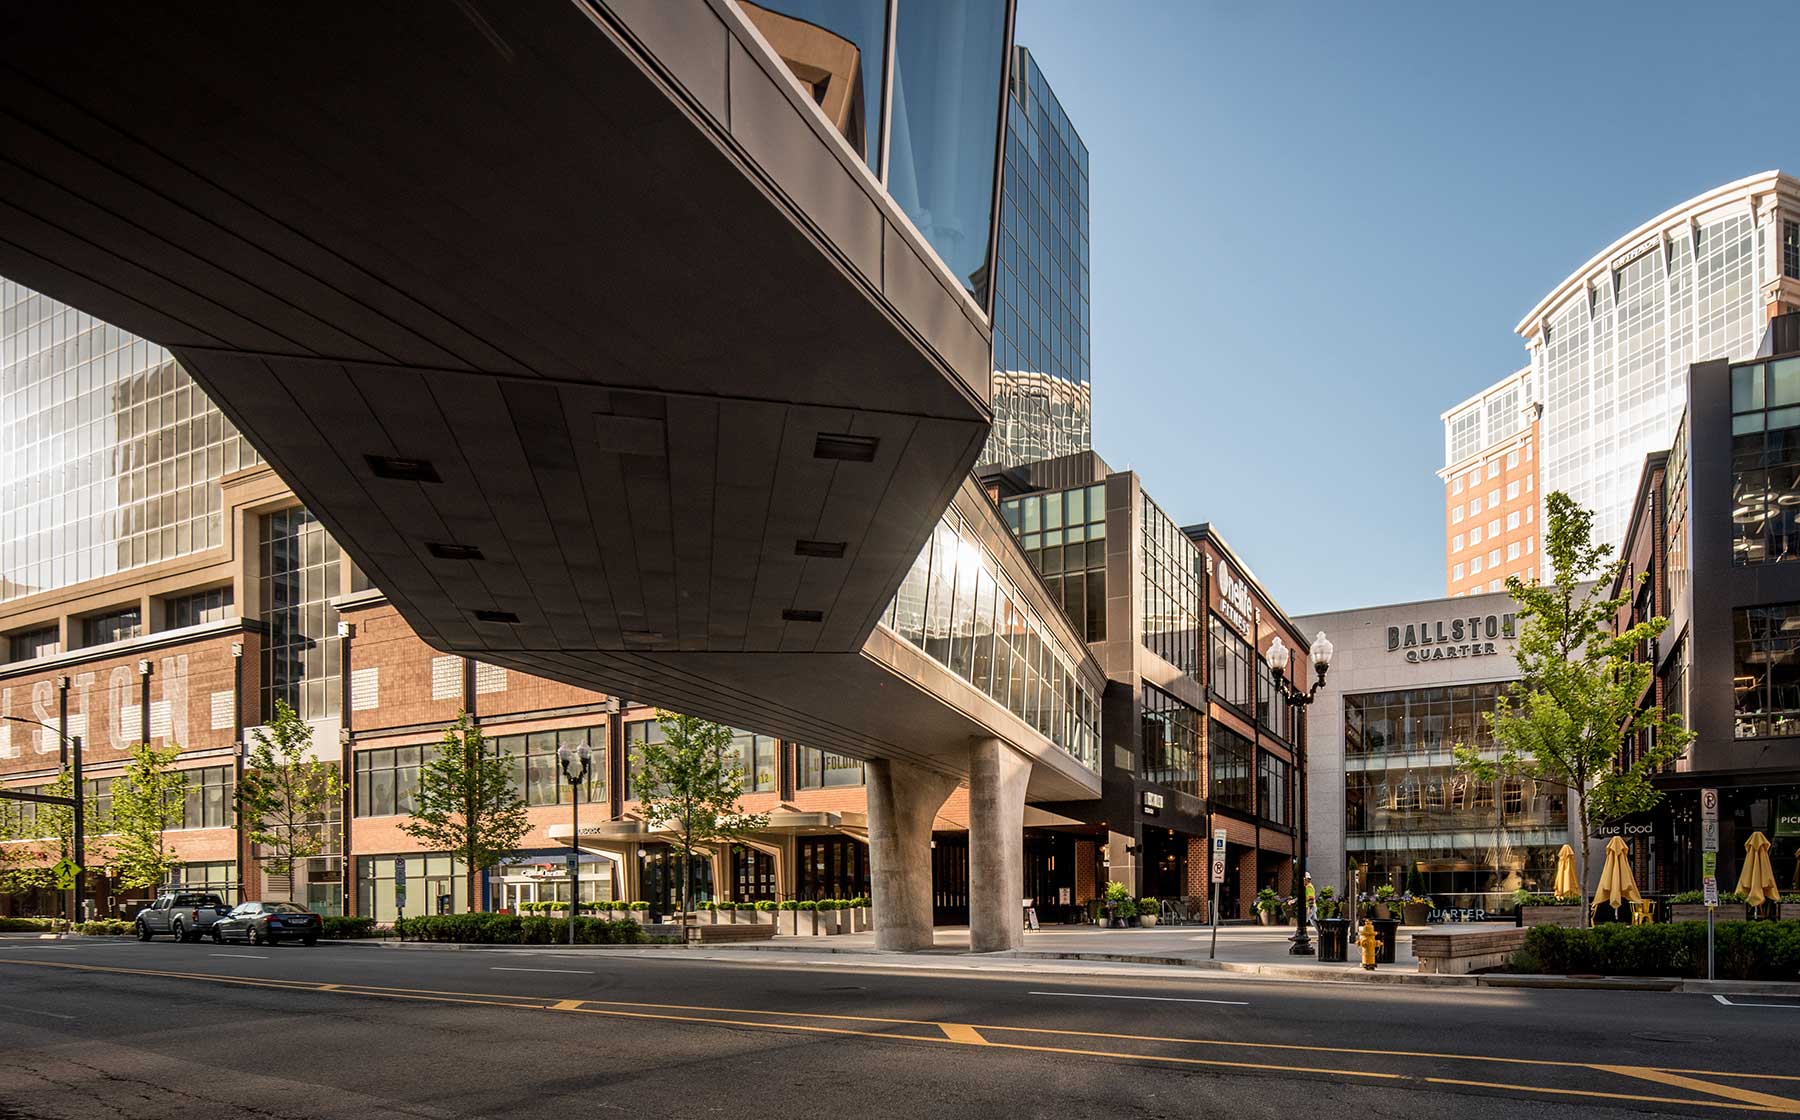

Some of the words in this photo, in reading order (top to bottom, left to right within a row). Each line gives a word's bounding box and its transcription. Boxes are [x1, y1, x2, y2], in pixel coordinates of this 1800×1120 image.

[1387, 613, 1518, 652] BALLSTON
[1405, 642, 1498, 663] QUARTER
[1624, 821, 1653, 835] Food
[1781, 816, 1800, 824] PIC
